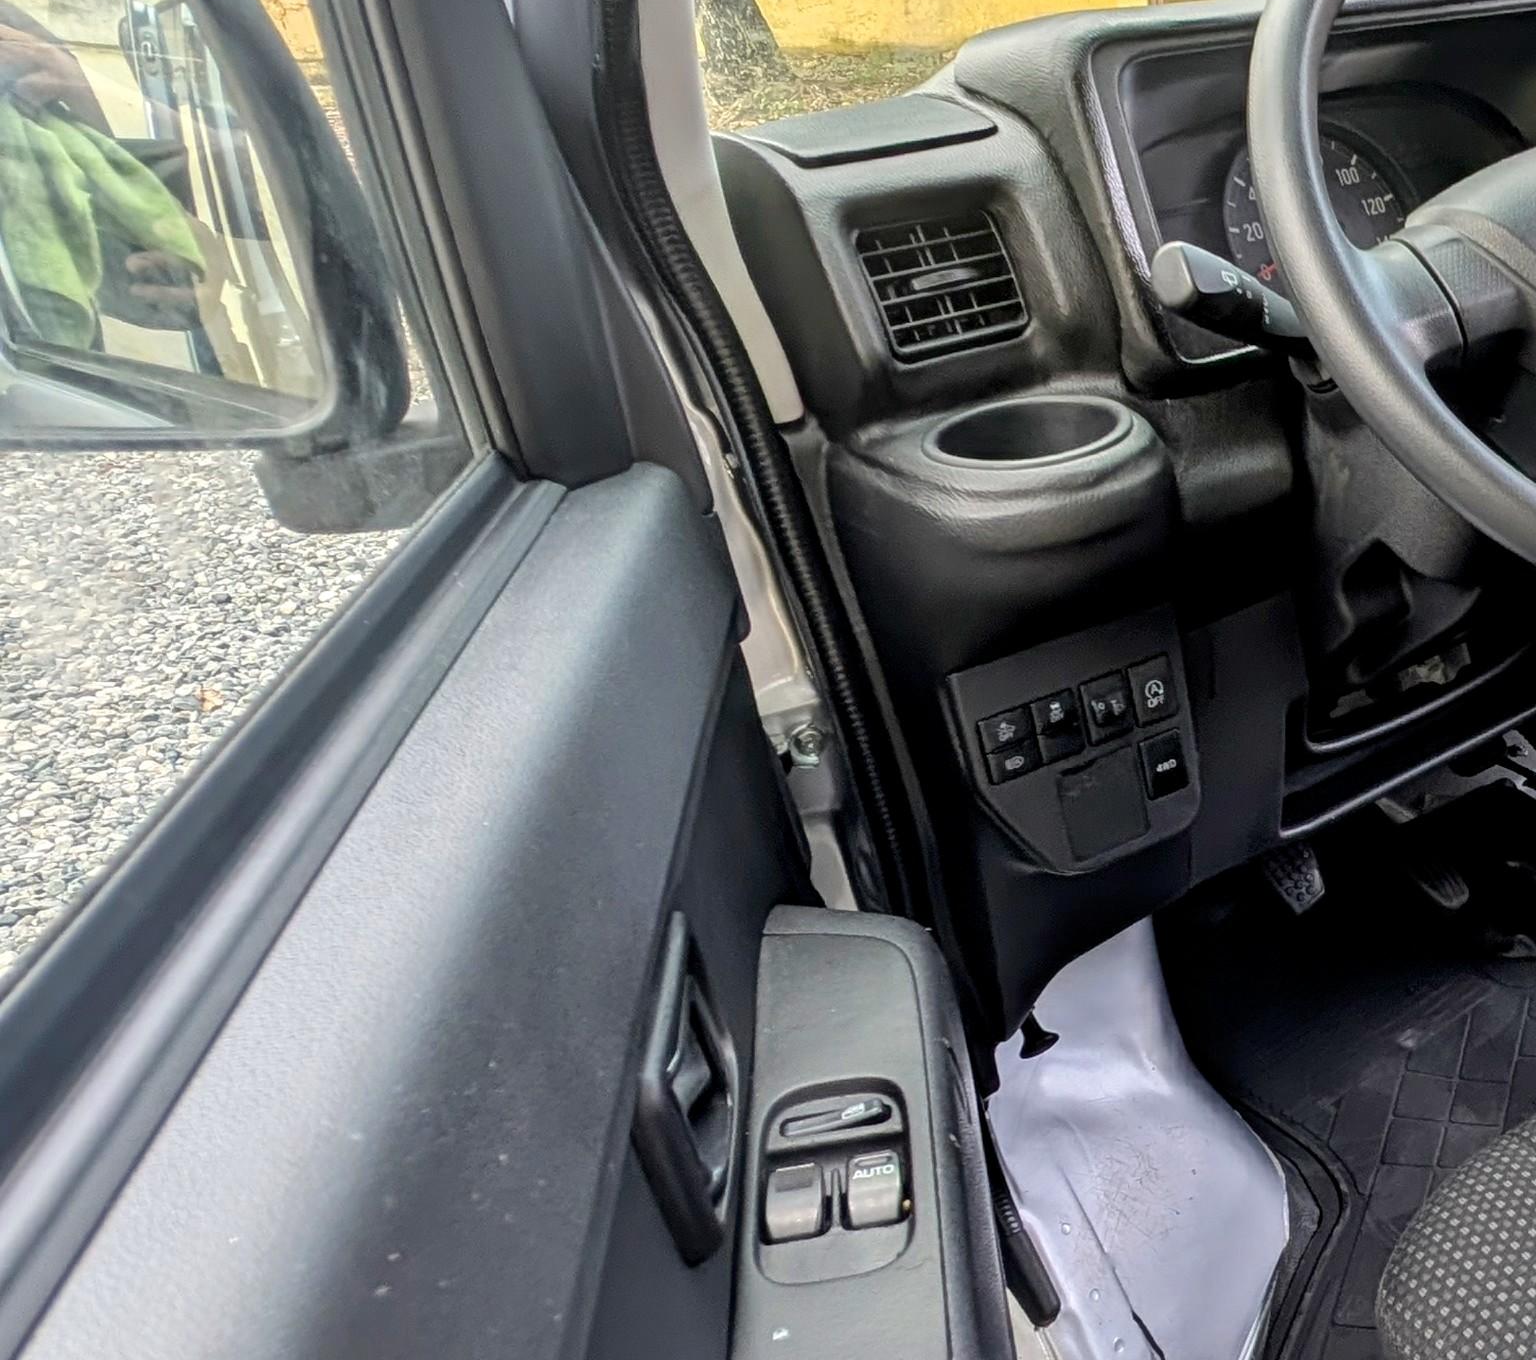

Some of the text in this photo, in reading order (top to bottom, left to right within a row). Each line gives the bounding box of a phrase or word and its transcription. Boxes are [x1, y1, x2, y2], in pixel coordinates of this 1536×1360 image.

[1335, 167, 1361, 187] 100
[1361, 196, 1386, 217] 120
[1243, 221, 1264, 242] 20
[852, 1163, 895, 1180] AUTO
